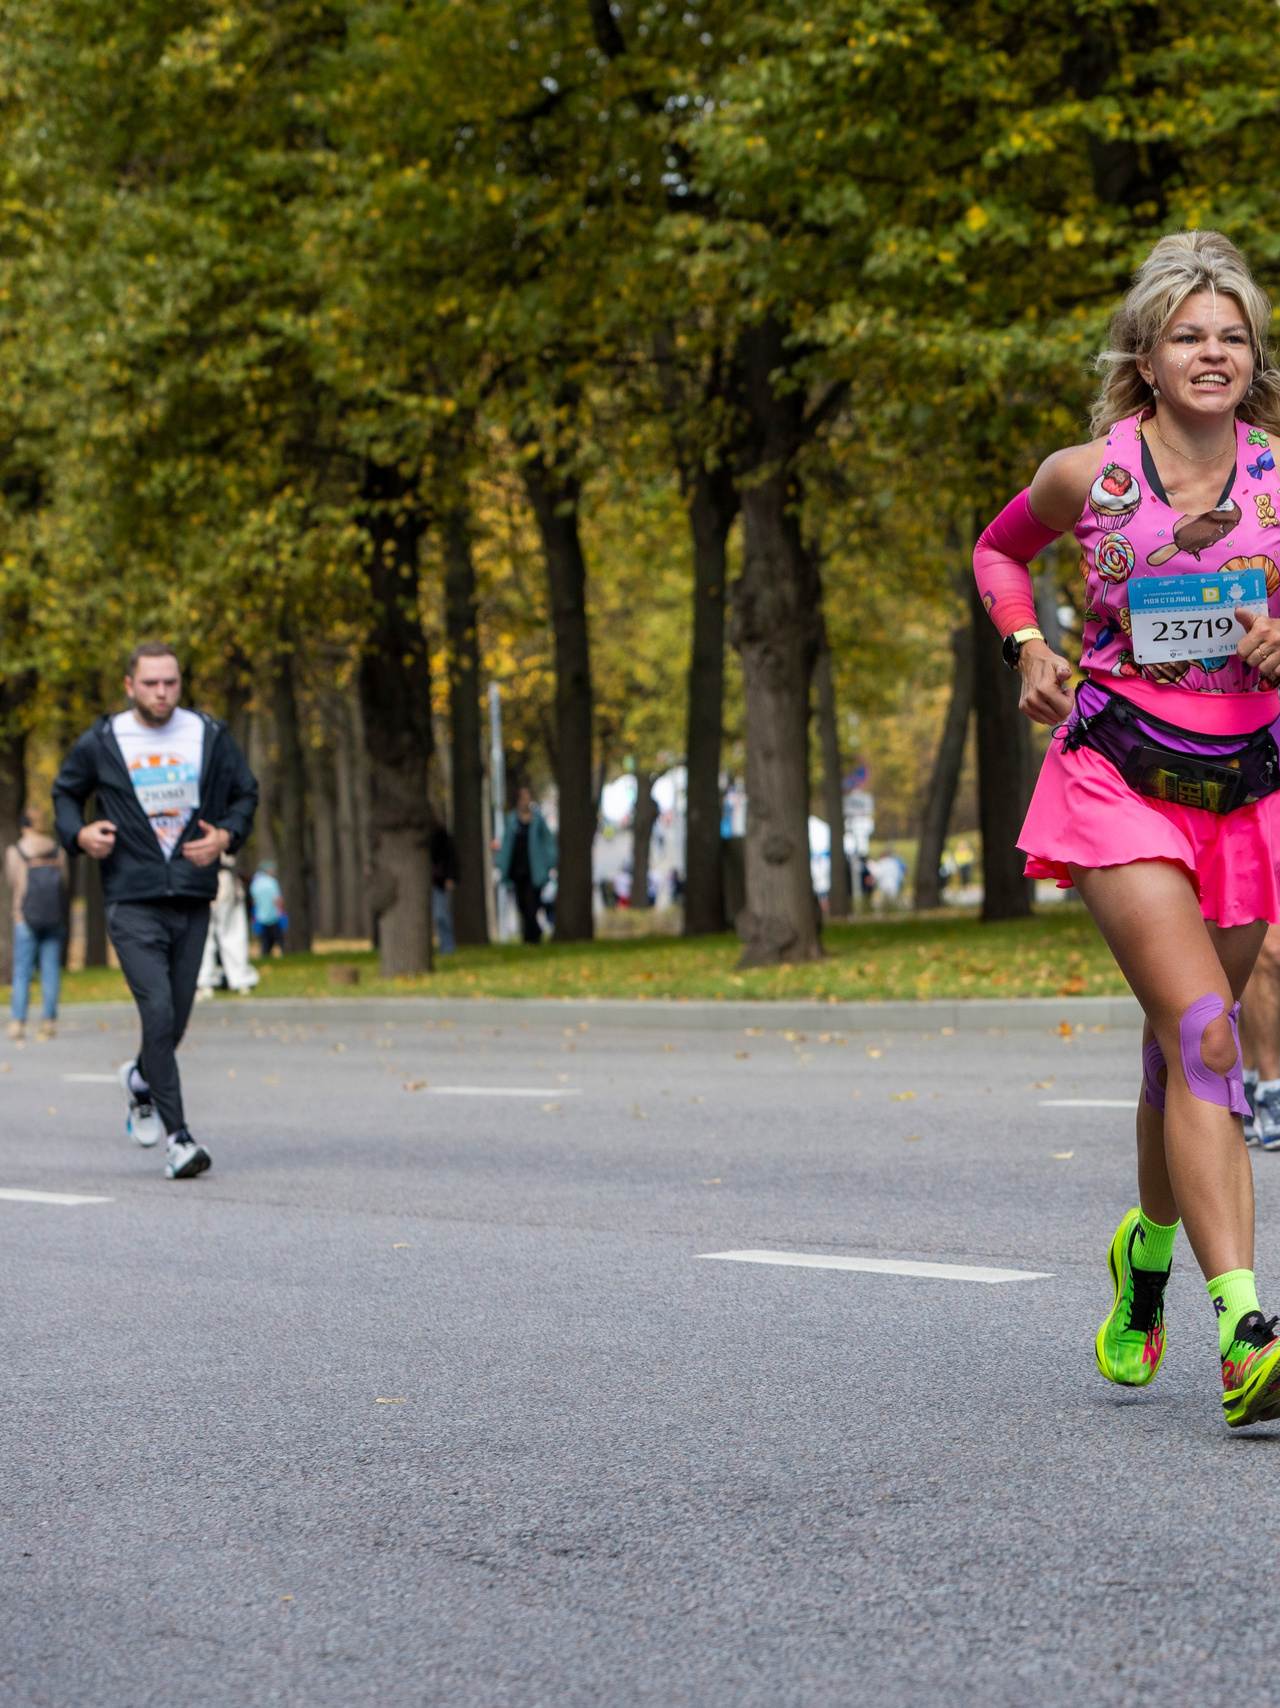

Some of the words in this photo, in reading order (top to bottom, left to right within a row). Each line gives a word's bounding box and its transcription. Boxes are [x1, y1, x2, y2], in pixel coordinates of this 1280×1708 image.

[1161, 595, 1196, 604] СТОЛИЦА
[1205, 589, 1217, 600] D
[1152, 617, 1233, 642] 23719
